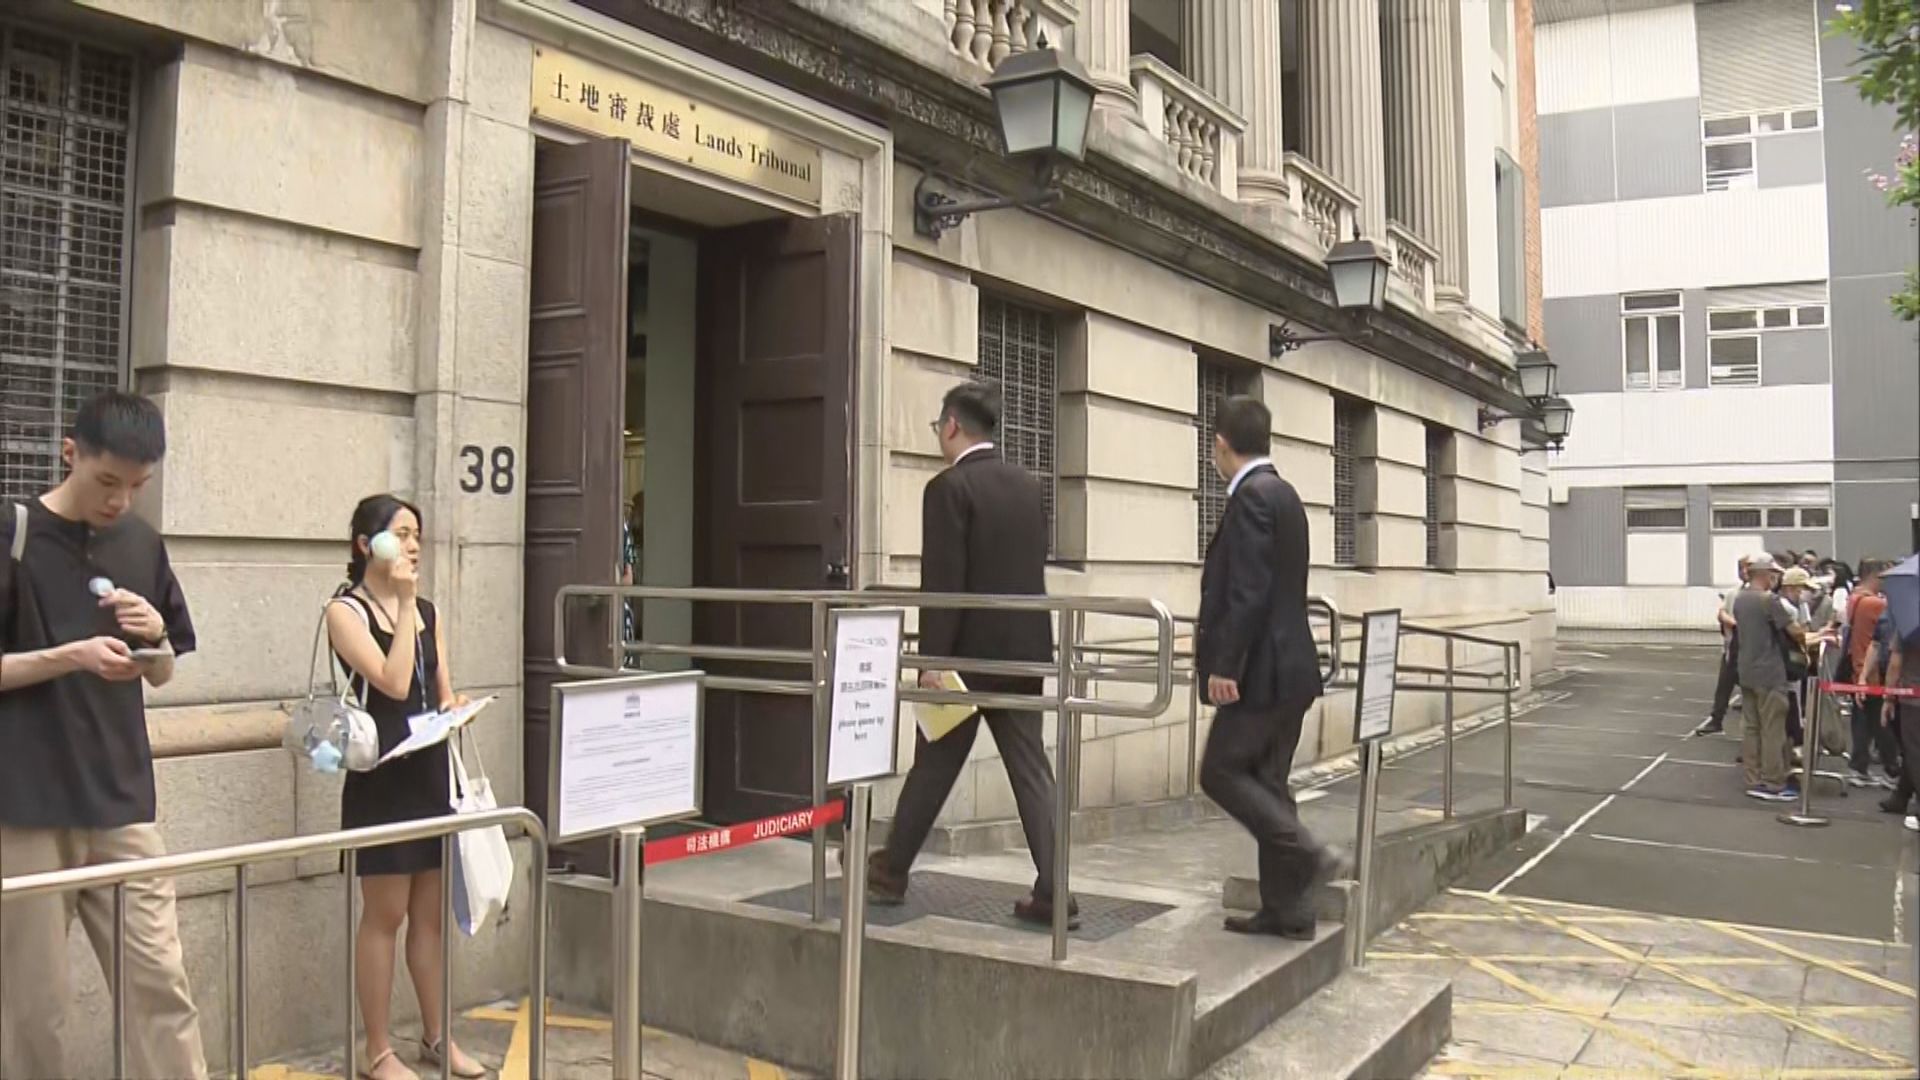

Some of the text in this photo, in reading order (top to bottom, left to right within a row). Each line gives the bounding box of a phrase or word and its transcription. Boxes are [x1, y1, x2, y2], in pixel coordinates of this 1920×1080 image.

[550, 71, 812, 183] 土地審裁處 Lands Tribunal
[460, 445, 515, 495] 38
[753, 810, 814, 839] JUDICIARY
